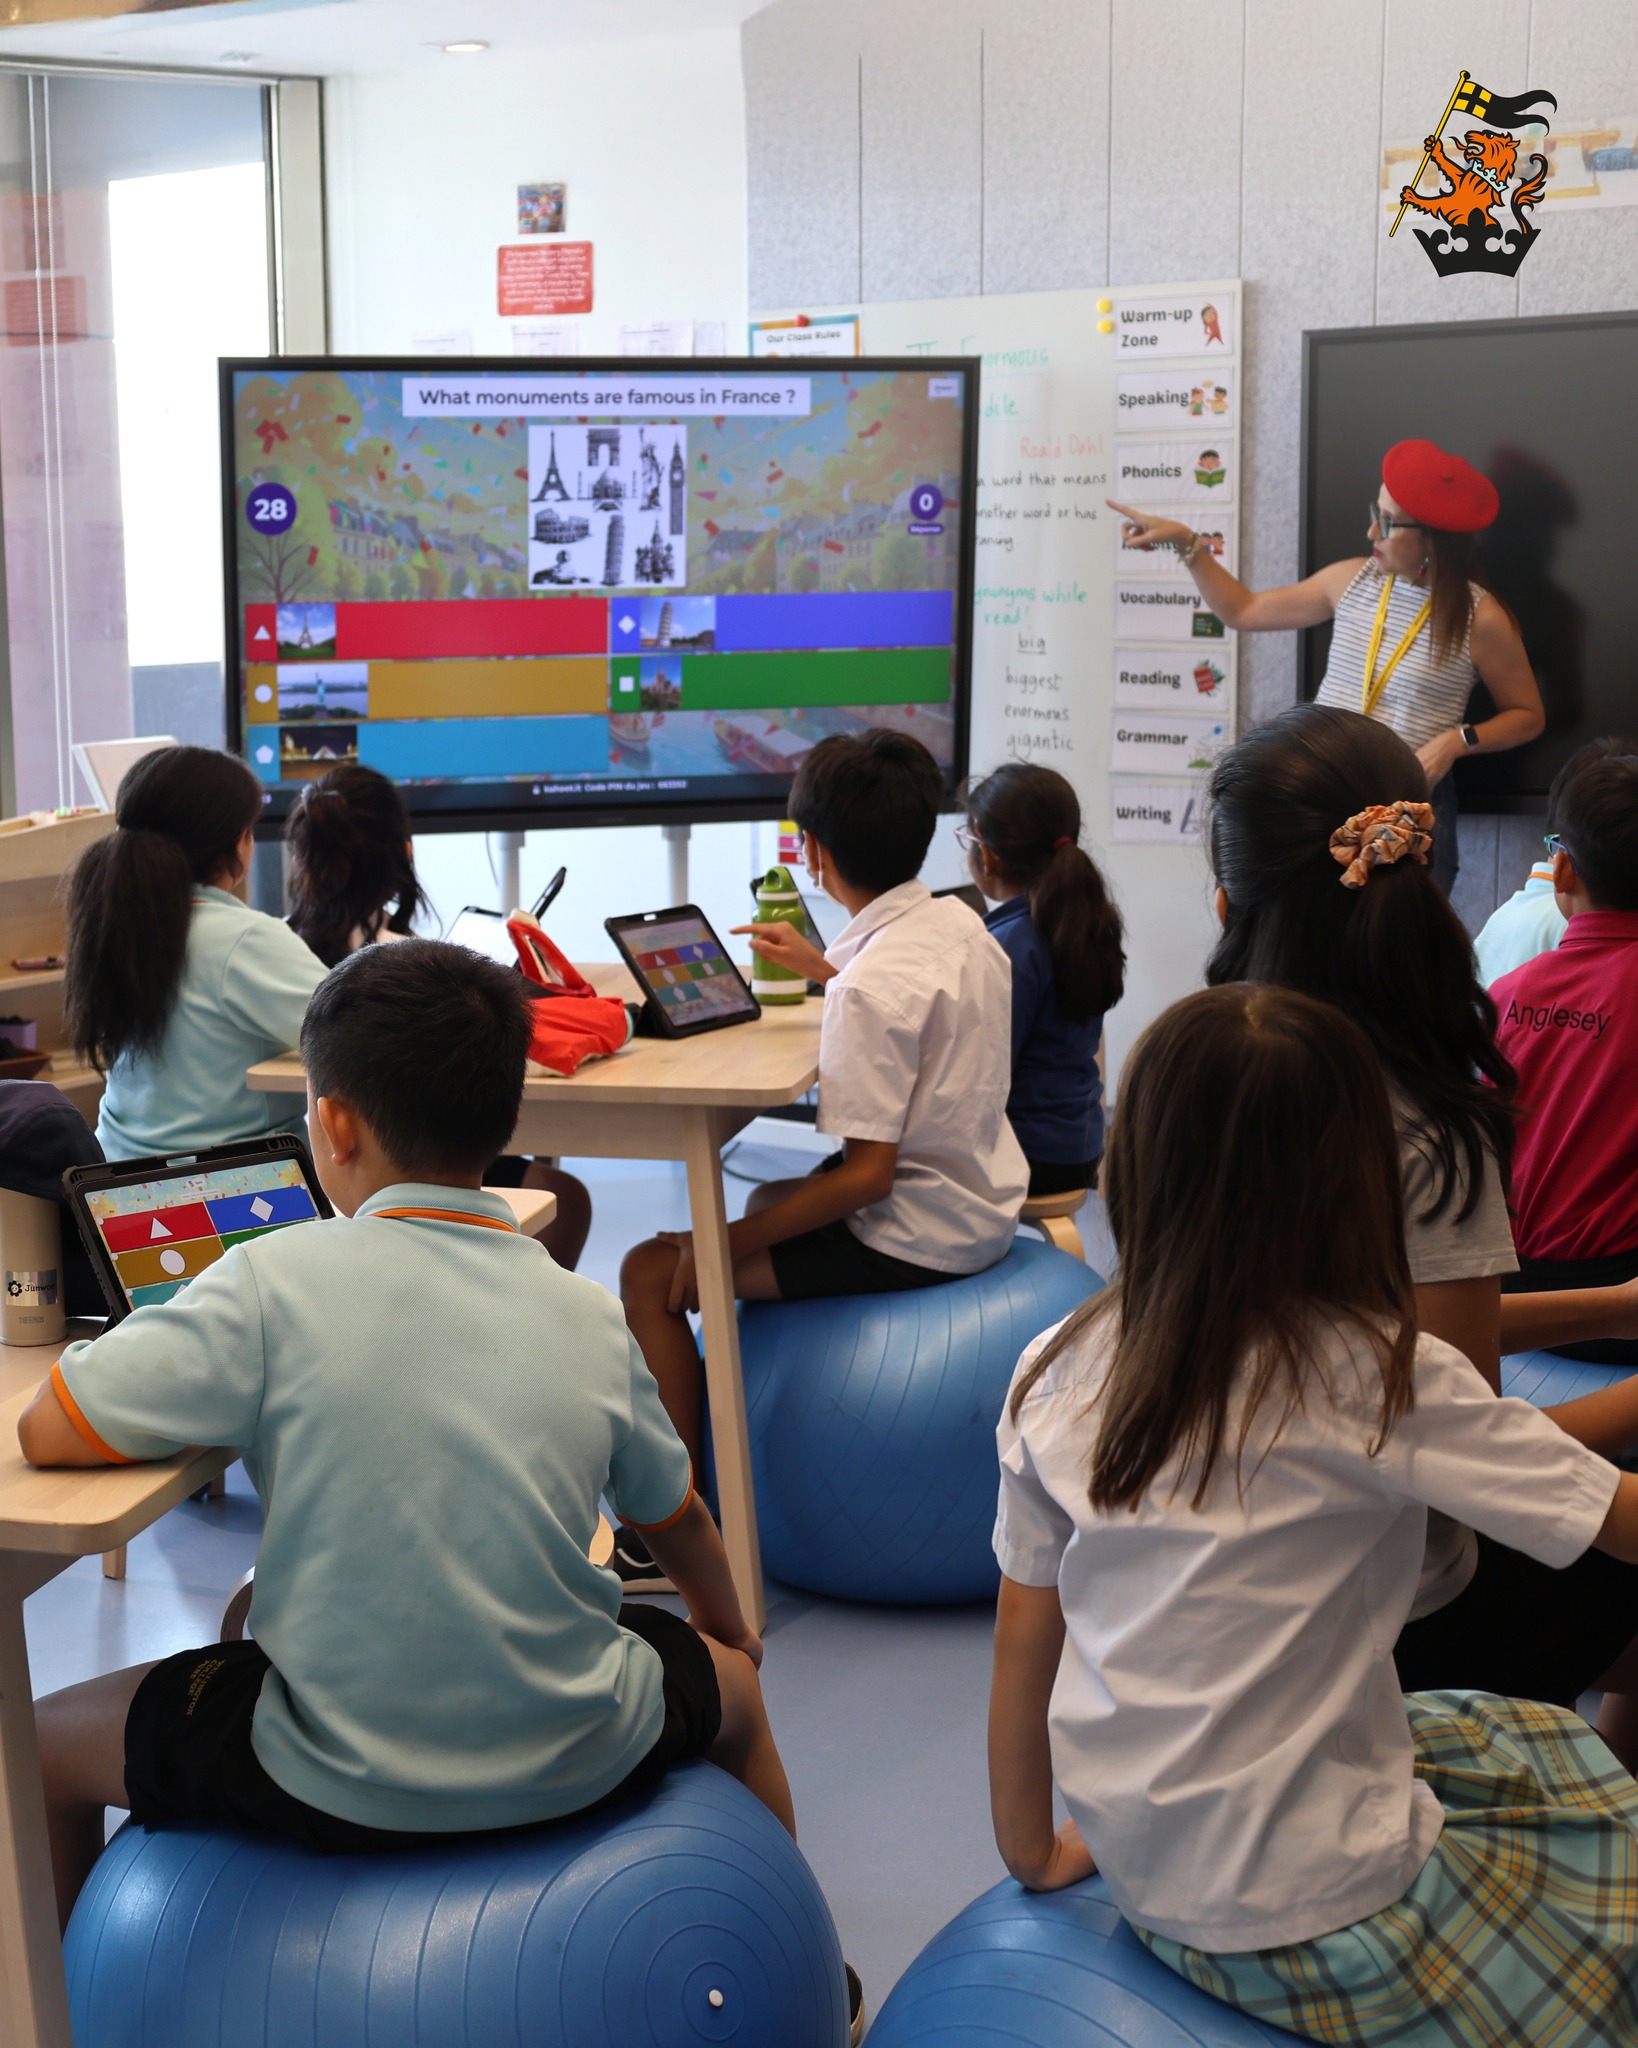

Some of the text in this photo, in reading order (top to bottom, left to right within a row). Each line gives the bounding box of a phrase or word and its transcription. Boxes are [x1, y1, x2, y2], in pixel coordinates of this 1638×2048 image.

[1120, 307, 1193, 324] Warm-up
[766, 330, 841, 344] Our Class Rules
[1121, 333, 1159, 348] Zone
[419, 387, 796, 405] What monuments are famous in France ?
[1118, 389, 1190, 409] Speaking
[1069, 432, 1105, 456] Dahl
[991, 470, 1022, 487] word
[1029, 471, 1057, 487] that
[1063, 473, 1107, 487] means
[1121, 463, 1182, 479] Phonics
[254, 498, 287, 521] 28
[919, 493, 934, 511] 0
[1023, 503, 1051, 518] word
[1057, 508, 1068, 519] or
[1074, 503, 1097, 520] has
[1042, 580, 1087, 603] while
[1120, 592, 1202, 609] Vocabulary
[1018, 631, 1046, 654] big
[1006, 664, 1063, 695] biggest
[1119, 670, 1181, 689] Reading
[1004, 703, 1070, 722] enormous
[1006, 727, 1075, 760] gigantic
[1117, 729, 1189, 746] Grammar
[584, 782, 607, 793] Code
[607, 782, 624, 792] PIN
[624, 781, 637, 791] du
[1116, 805, 1172, 824] Writing
[1504, 1000, 1611, 1040] Anglesey
